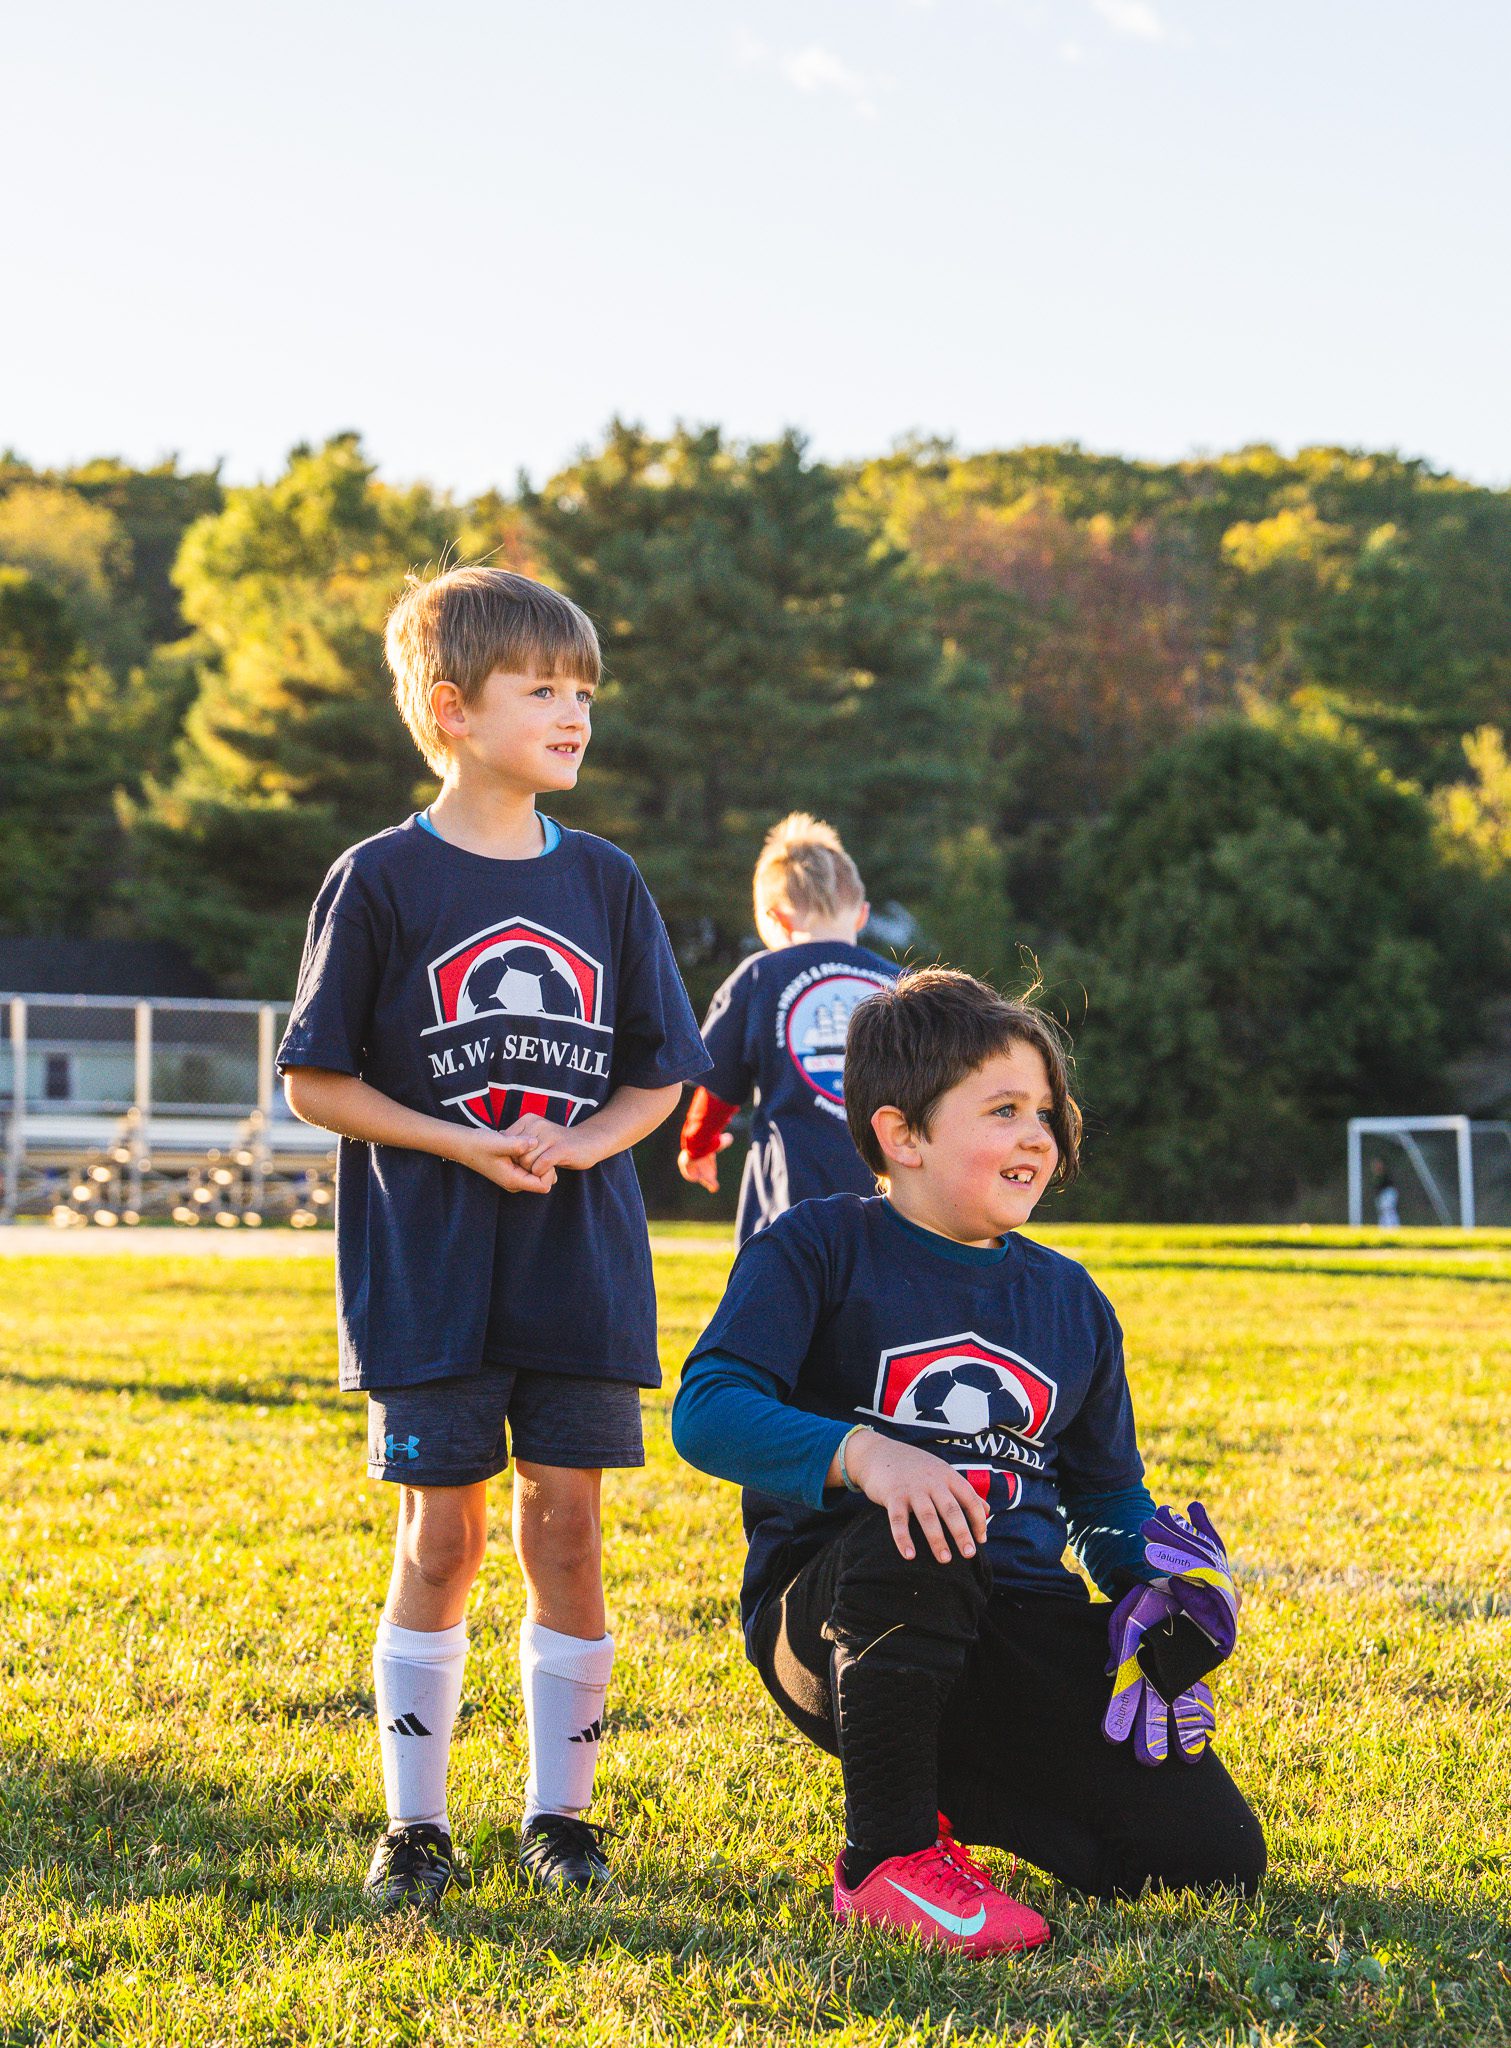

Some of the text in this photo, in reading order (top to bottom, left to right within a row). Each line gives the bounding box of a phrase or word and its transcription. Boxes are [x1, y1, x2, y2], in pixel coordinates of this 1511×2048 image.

[502, 1034, 610, 1079] SEWALL
[935, 1433, 1046, 1471] WALL
[1155, 1551, 1191, 1567] Jalunth
[1114, 1693, 1130, 1730] Jalunth
